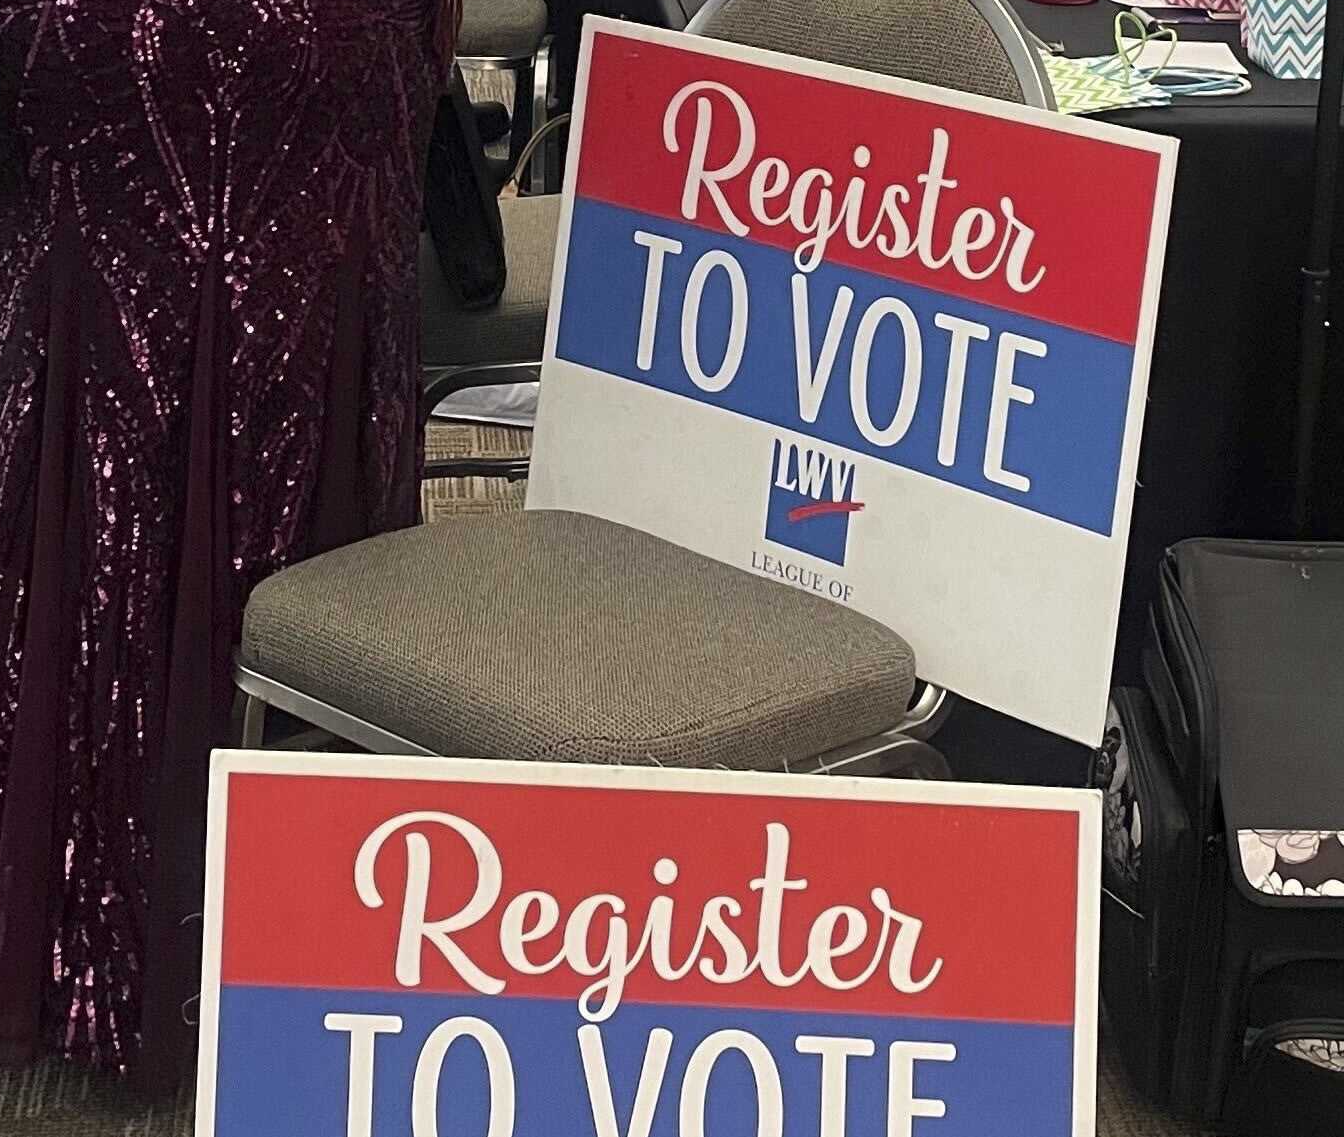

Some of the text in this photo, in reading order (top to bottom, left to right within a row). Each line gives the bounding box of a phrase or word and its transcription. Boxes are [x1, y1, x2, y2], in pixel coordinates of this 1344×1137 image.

[663, 80, 1046, 293] Register
[633, 230, 1048, 493] TO VOTE
[774, 439, 855, 504] LWV
[751, 550, 854, 602] LEAGUE OF
[353, 810, 944, 1022] Register
[323, 1012, 957, 1137] TO VOTE
